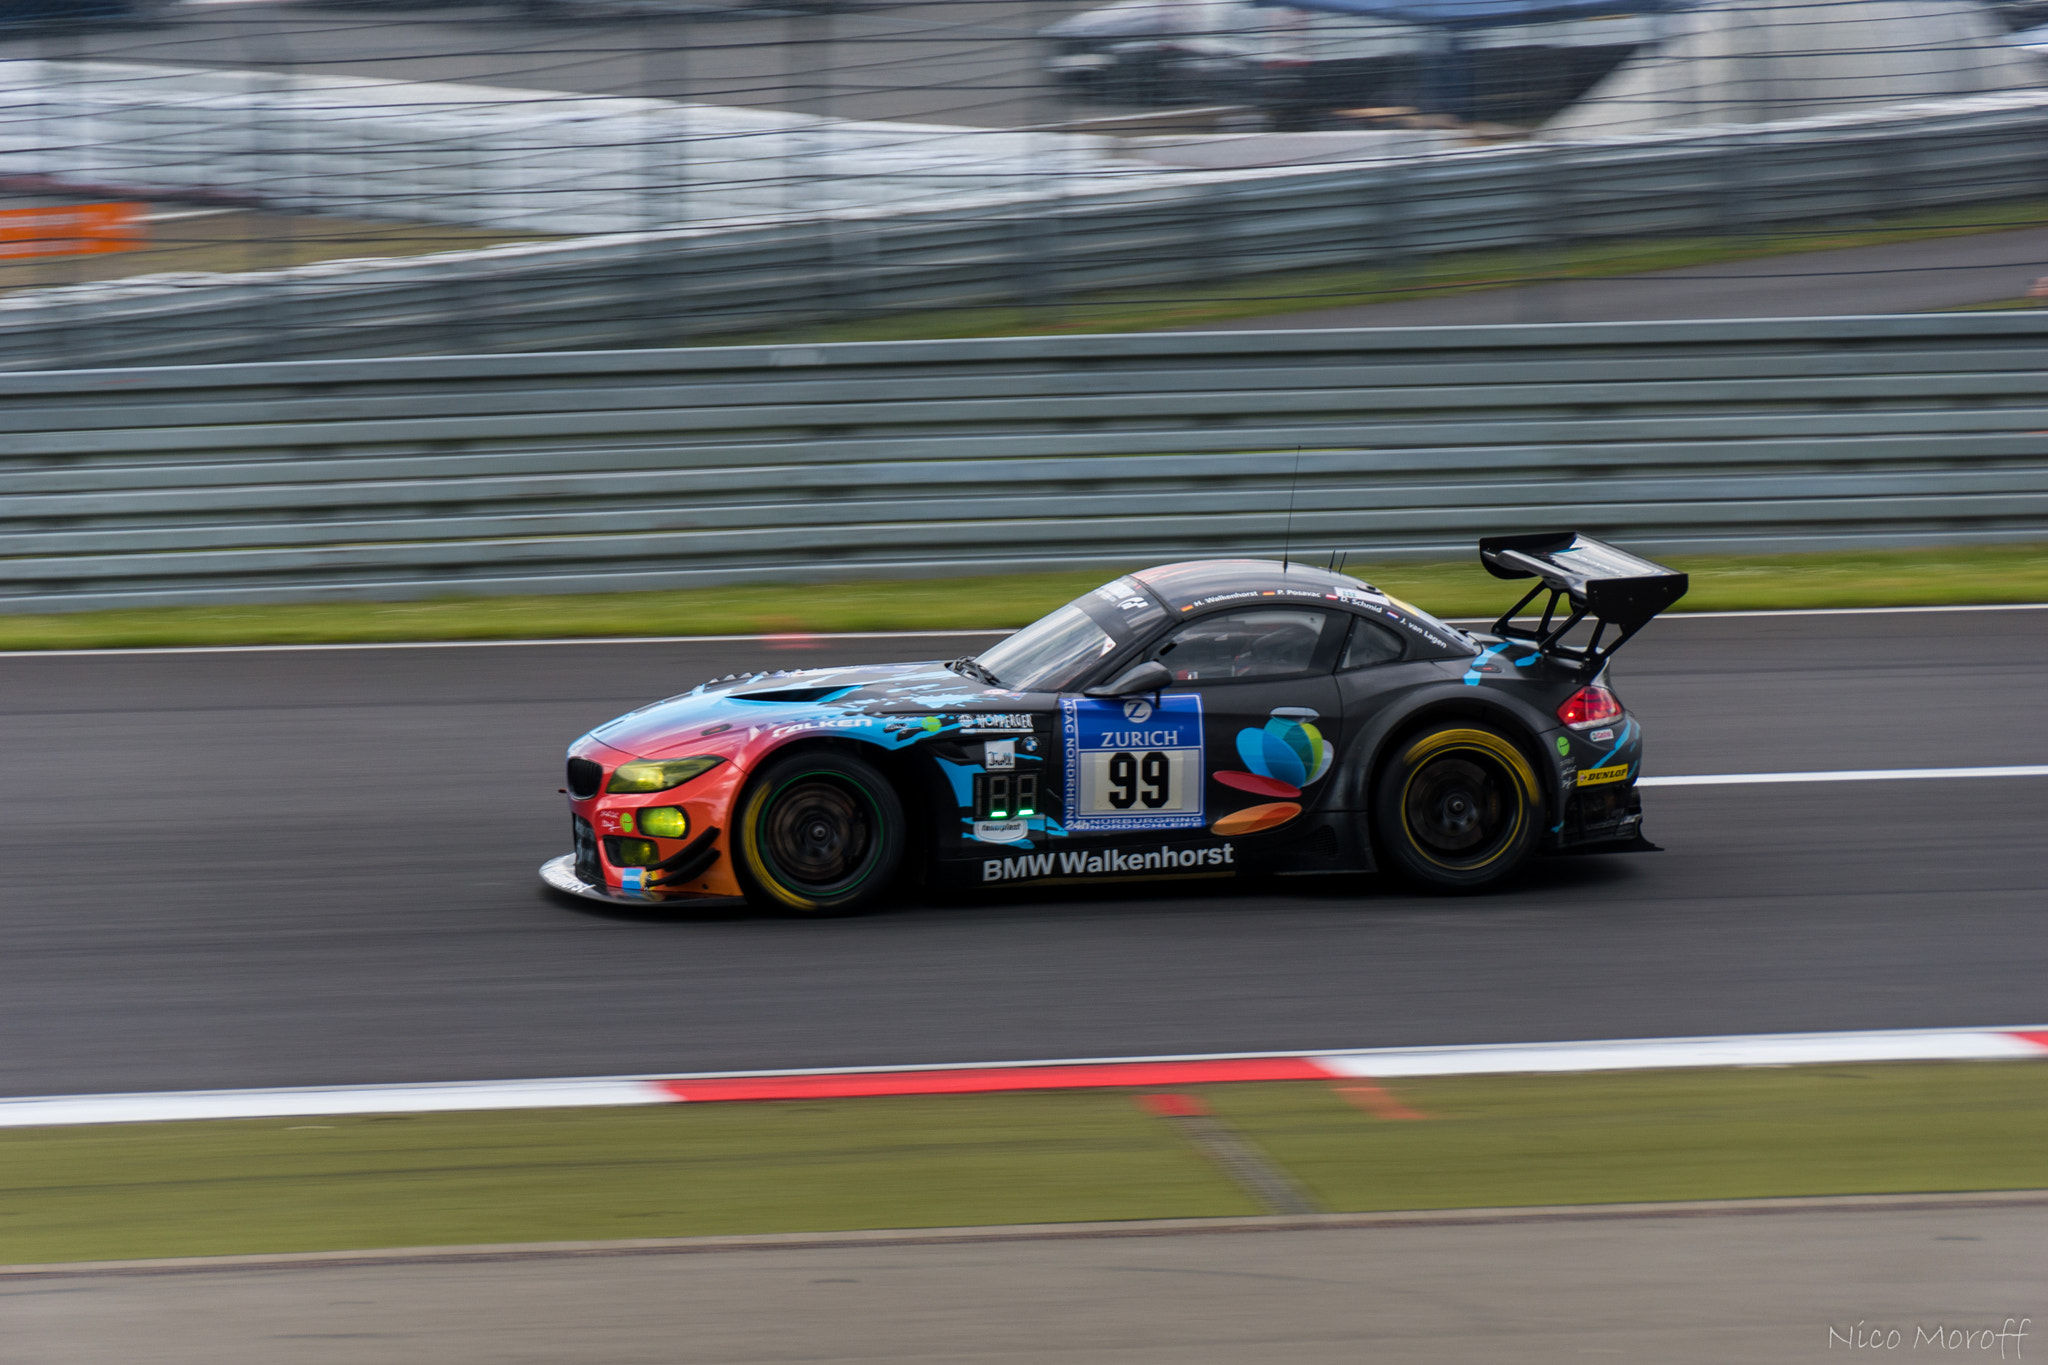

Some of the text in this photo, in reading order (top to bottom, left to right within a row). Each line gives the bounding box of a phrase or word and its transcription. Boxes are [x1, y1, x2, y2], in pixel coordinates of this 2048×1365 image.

[1205, 590, 1258, 603] Walkenhorst
[1287, 589, 1321, 598] Posavac
[1352, 598, 1383, 613] Schmid
[771, 718, 873, 738] FALKEN
[1100, 730, 1178, 748] ZURICH
[1063, 700, 1076, 819] ADAC NORDRHEIN
[1108, 751, 1171, 810] 99
[1587, 768, 1627, 781] DUNLOP
[1090, 822, 1202, 830] NORDSCHLEIFE
[982, 842, 1235, 882] BMW Walkenhorst
